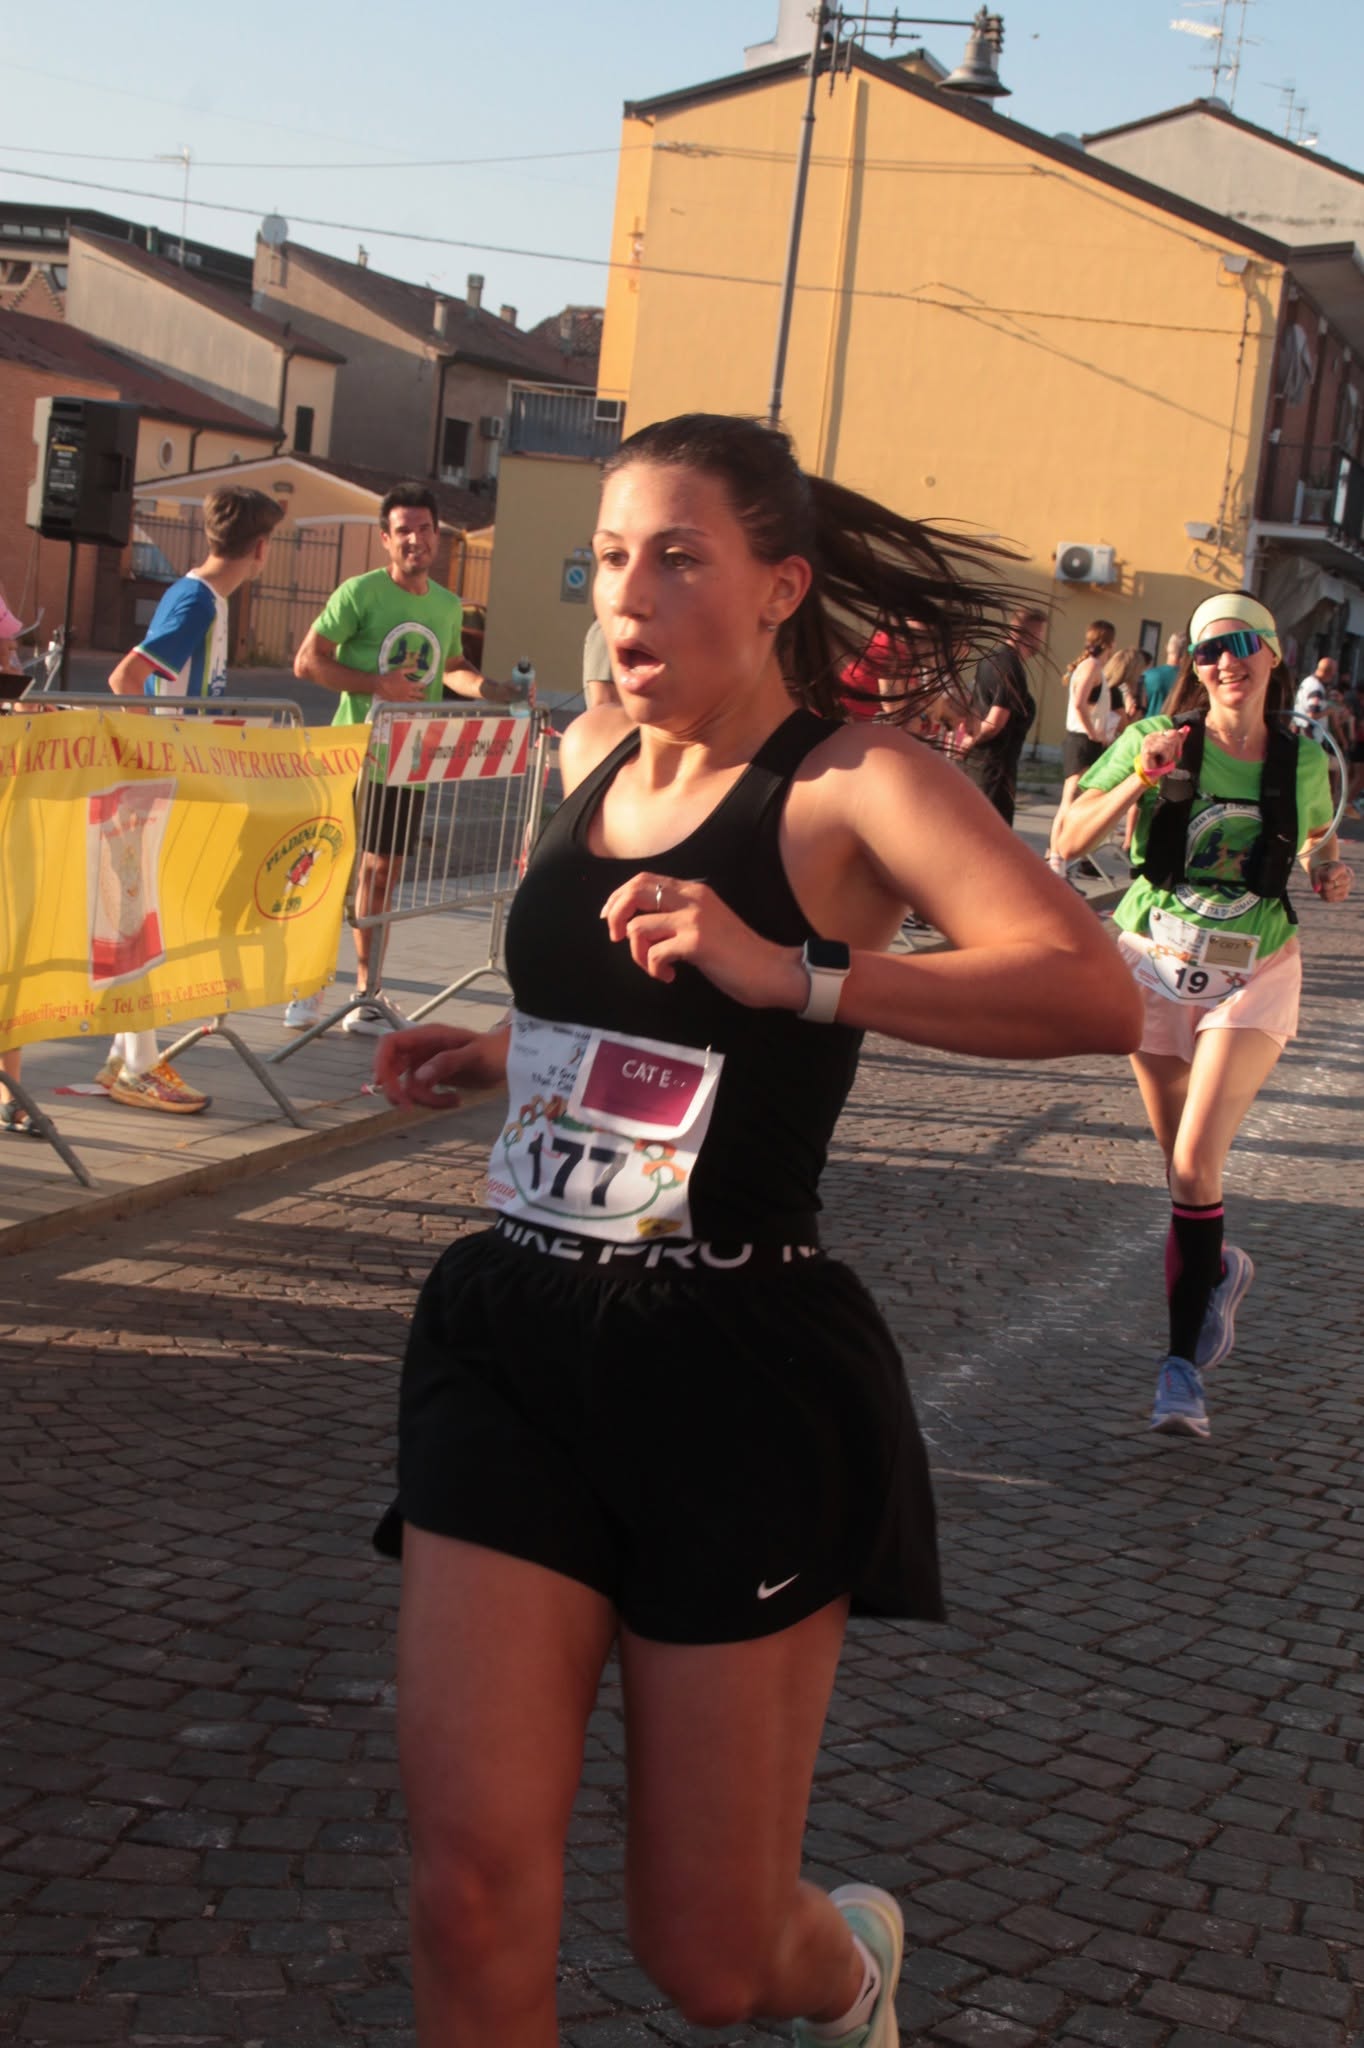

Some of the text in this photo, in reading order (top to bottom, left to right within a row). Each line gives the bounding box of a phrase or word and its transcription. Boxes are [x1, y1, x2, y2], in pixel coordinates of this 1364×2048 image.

[182, 744, 209, 774] AL
[209, 747, 362, 779] SUPERMERCATO
[1175, 967, 1209, 994] 19
[527, 1132, 629, 1208] 177
